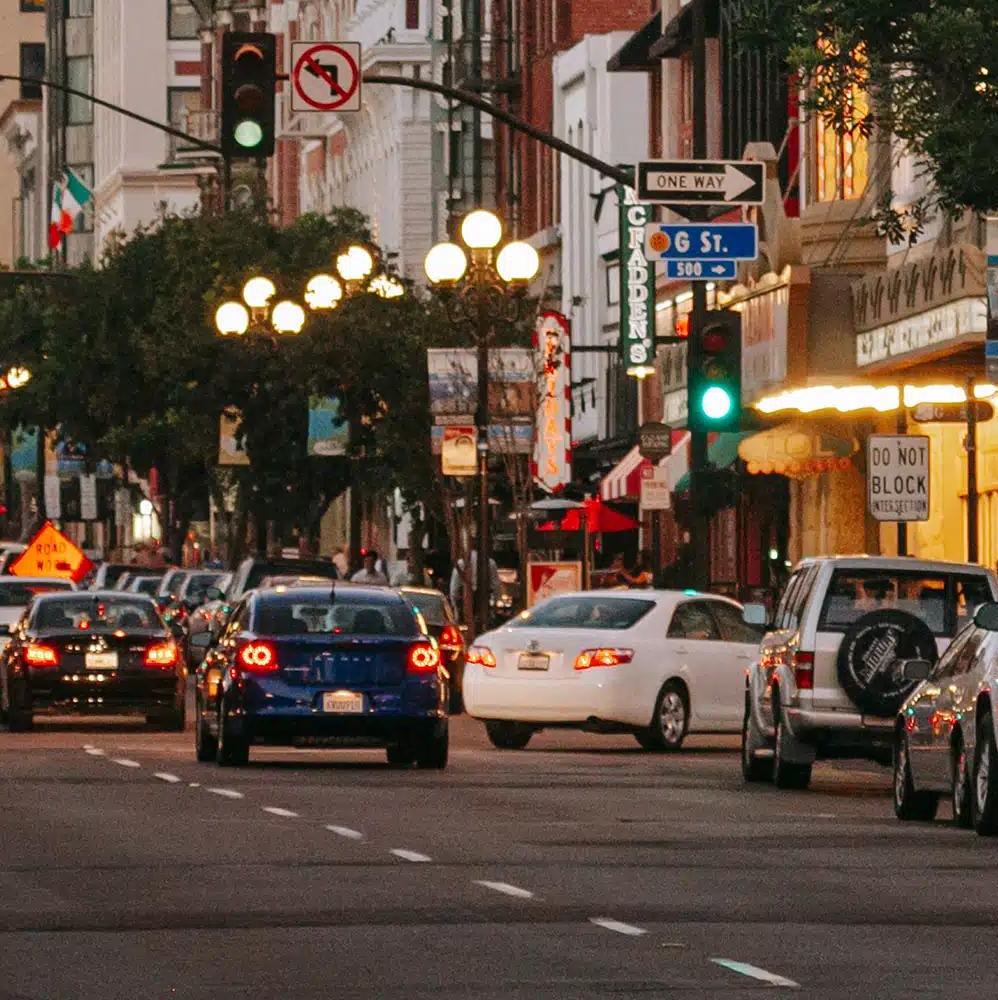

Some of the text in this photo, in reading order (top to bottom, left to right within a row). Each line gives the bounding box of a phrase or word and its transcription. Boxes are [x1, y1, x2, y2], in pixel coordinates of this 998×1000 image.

[657, 175, 725, 188] ONE WAY
[675, 231, 690, 253] G
[676, 262, 703, 277] 500
[873, 447, 890, 466] DO
[898, 447, 926, 466] NOT
[872, 476, 926, 494] BLOCK
[36, 543, 67, 554] ROAD
[37, 560, 71, 571] WO
